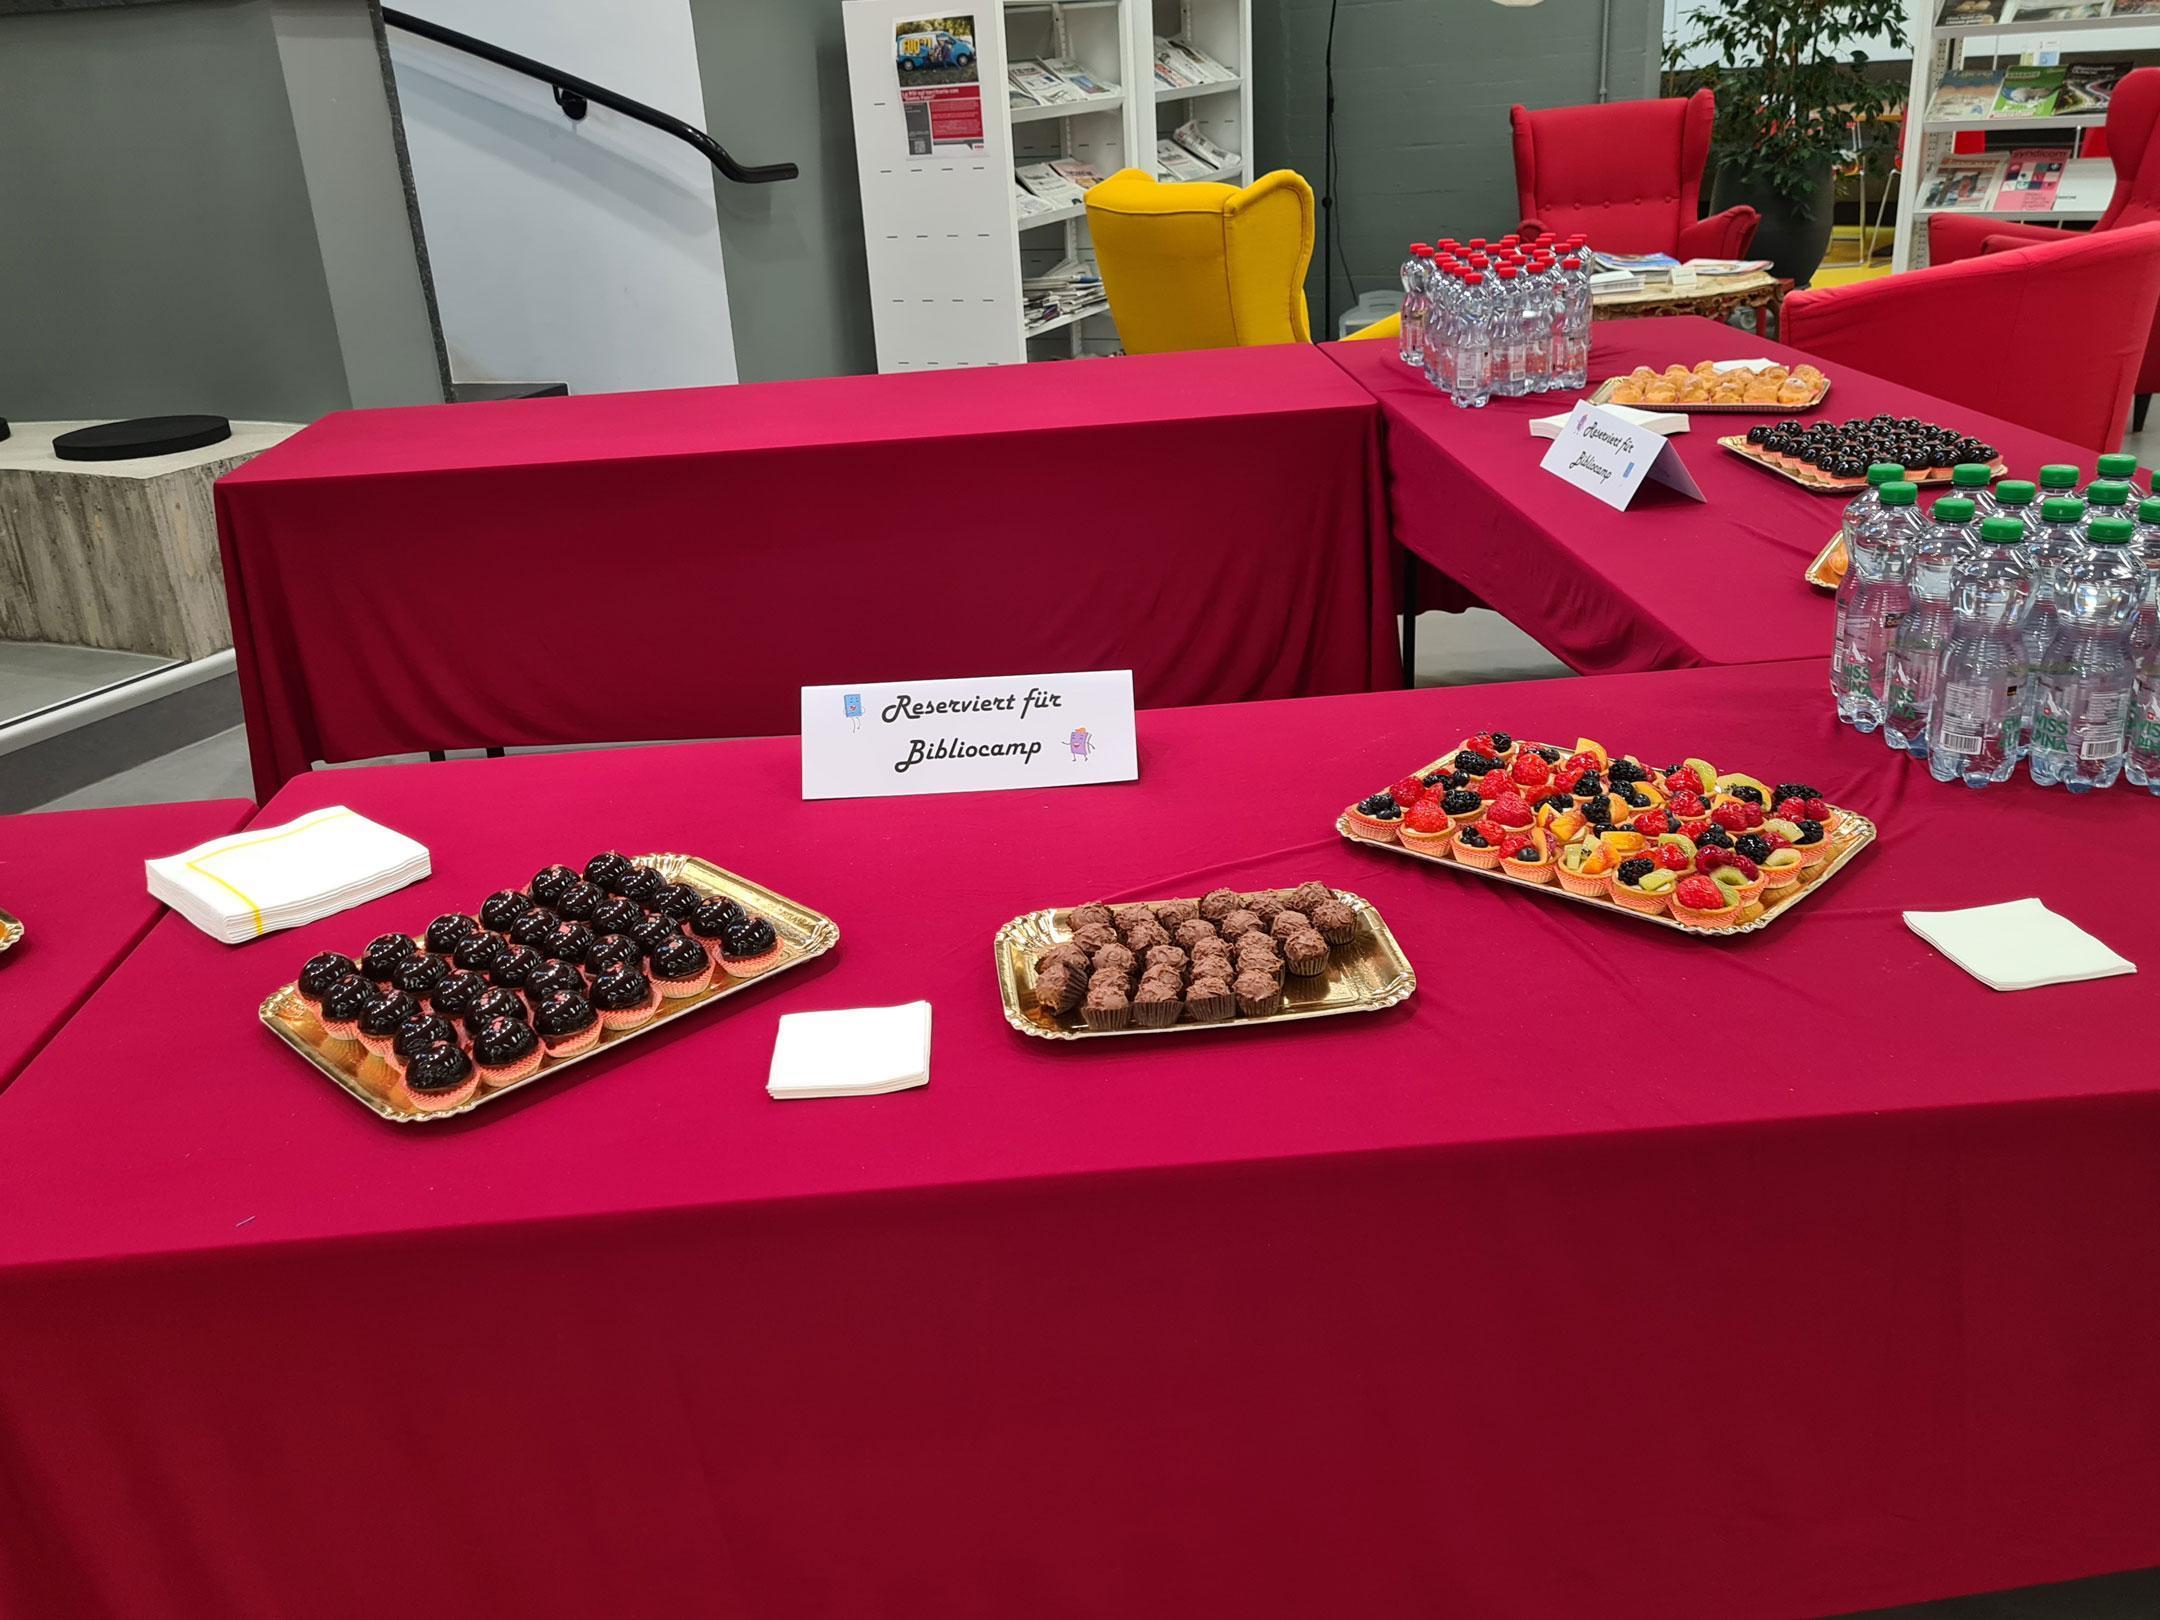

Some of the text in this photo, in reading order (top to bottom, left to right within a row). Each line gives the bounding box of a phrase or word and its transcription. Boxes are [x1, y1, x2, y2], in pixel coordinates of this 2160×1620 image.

[1583, 421, 1635, 455] Reserviert für
[1568, 450, 1612, 485] Bibliocamp
[881, 687, 1062, 723] Reserviert für
[894, 737, 1042, 773] Bibliocamp
